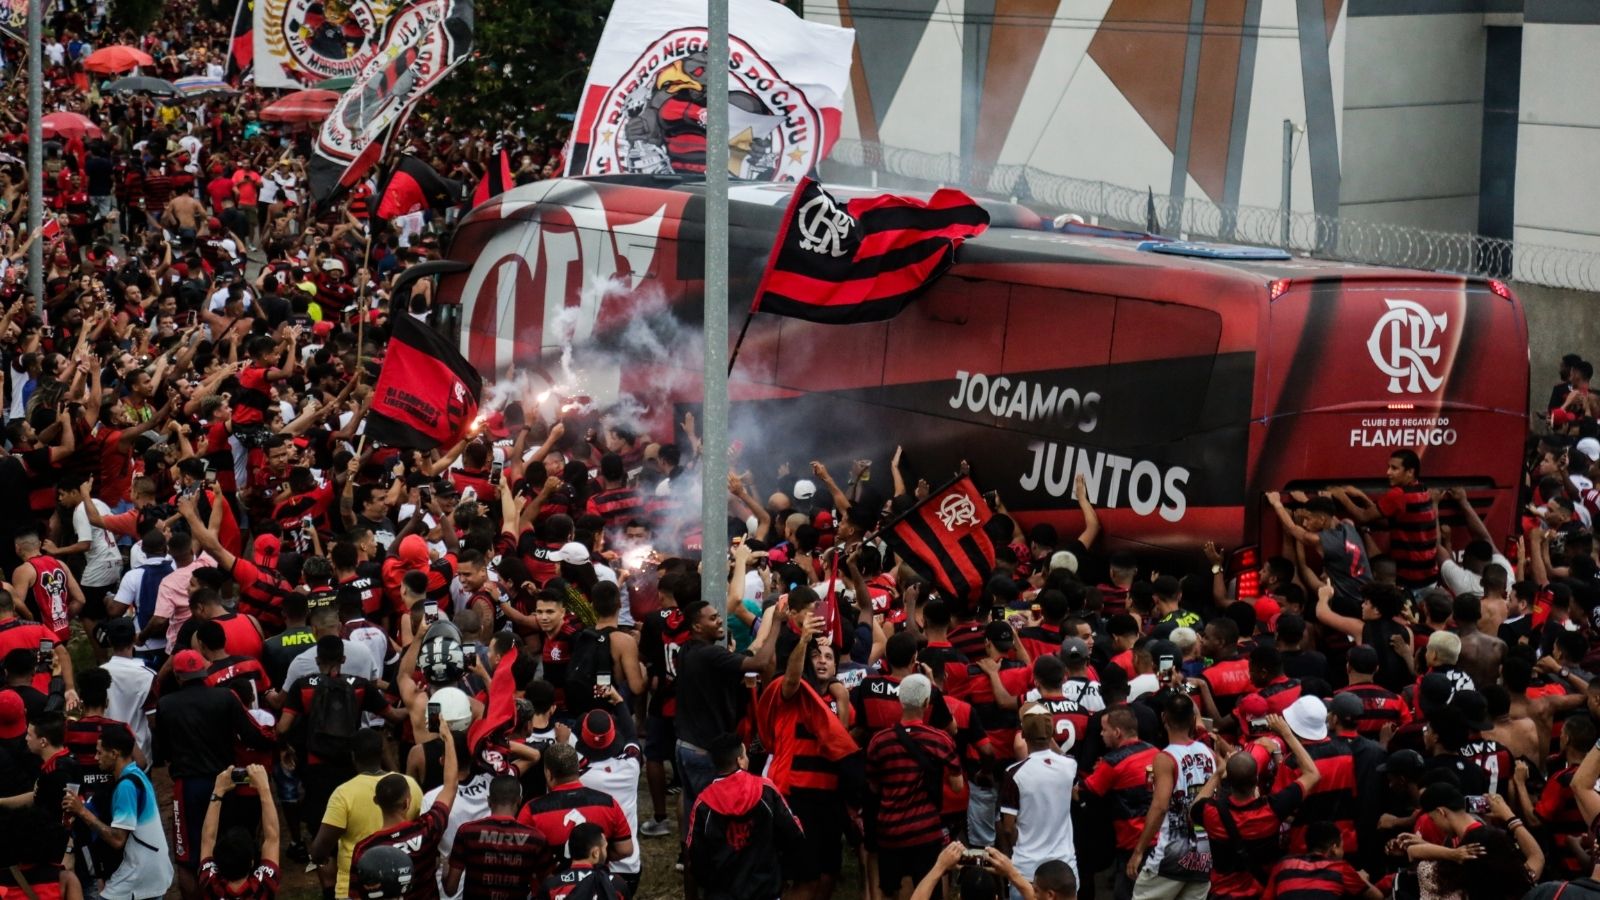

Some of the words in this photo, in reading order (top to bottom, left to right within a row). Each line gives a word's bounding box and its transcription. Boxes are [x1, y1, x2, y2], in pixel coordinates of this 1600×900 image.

[744, 66, 774, 91] DO
[770, 90, 808, 145] CAJU
[949, 370, 1101, 433] JOGAMOS
[1362, 418, 1387, 427] CLUBE
[1389, 418, 1400, 427] DE
[1402, 418, 1436, 427] REGATAS
[1437, 417, 1449, 427] DO
[1350, 428, 1457, 447] FLAMENGO
[1019, 440, 1191, 523] JUNTOS
[1051, 701, 1079, 713] MRV
[478, 830, 531, 847] MRV
